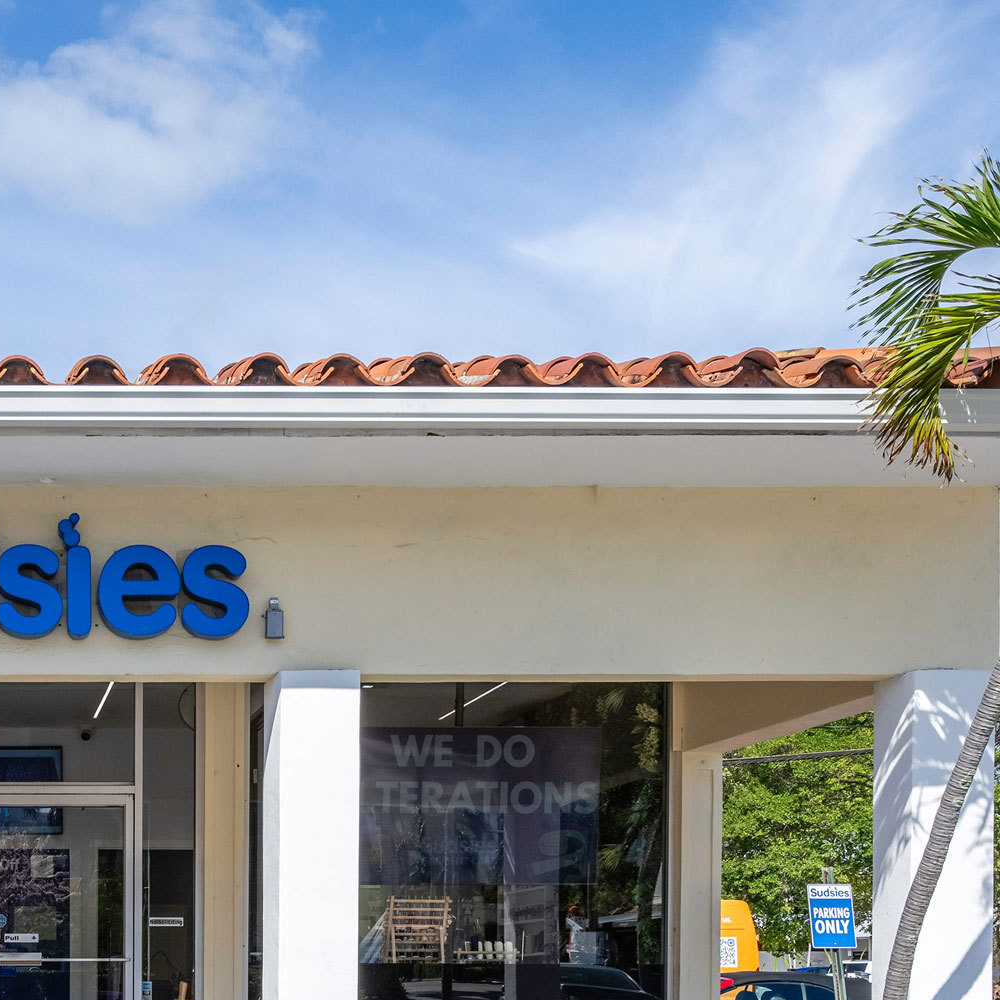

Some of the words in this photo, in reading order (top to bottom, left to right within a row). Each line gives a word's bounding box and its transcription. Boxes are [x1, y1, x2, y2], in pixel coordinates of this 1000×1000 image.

[390, 734, 454, 768] WE
[476, 734, 536, 768] DO
[810, 886, 850, 898] Sudsies
[812, 906, 851, 919] PARKING
[814, 919, 850, 934] ONLY
